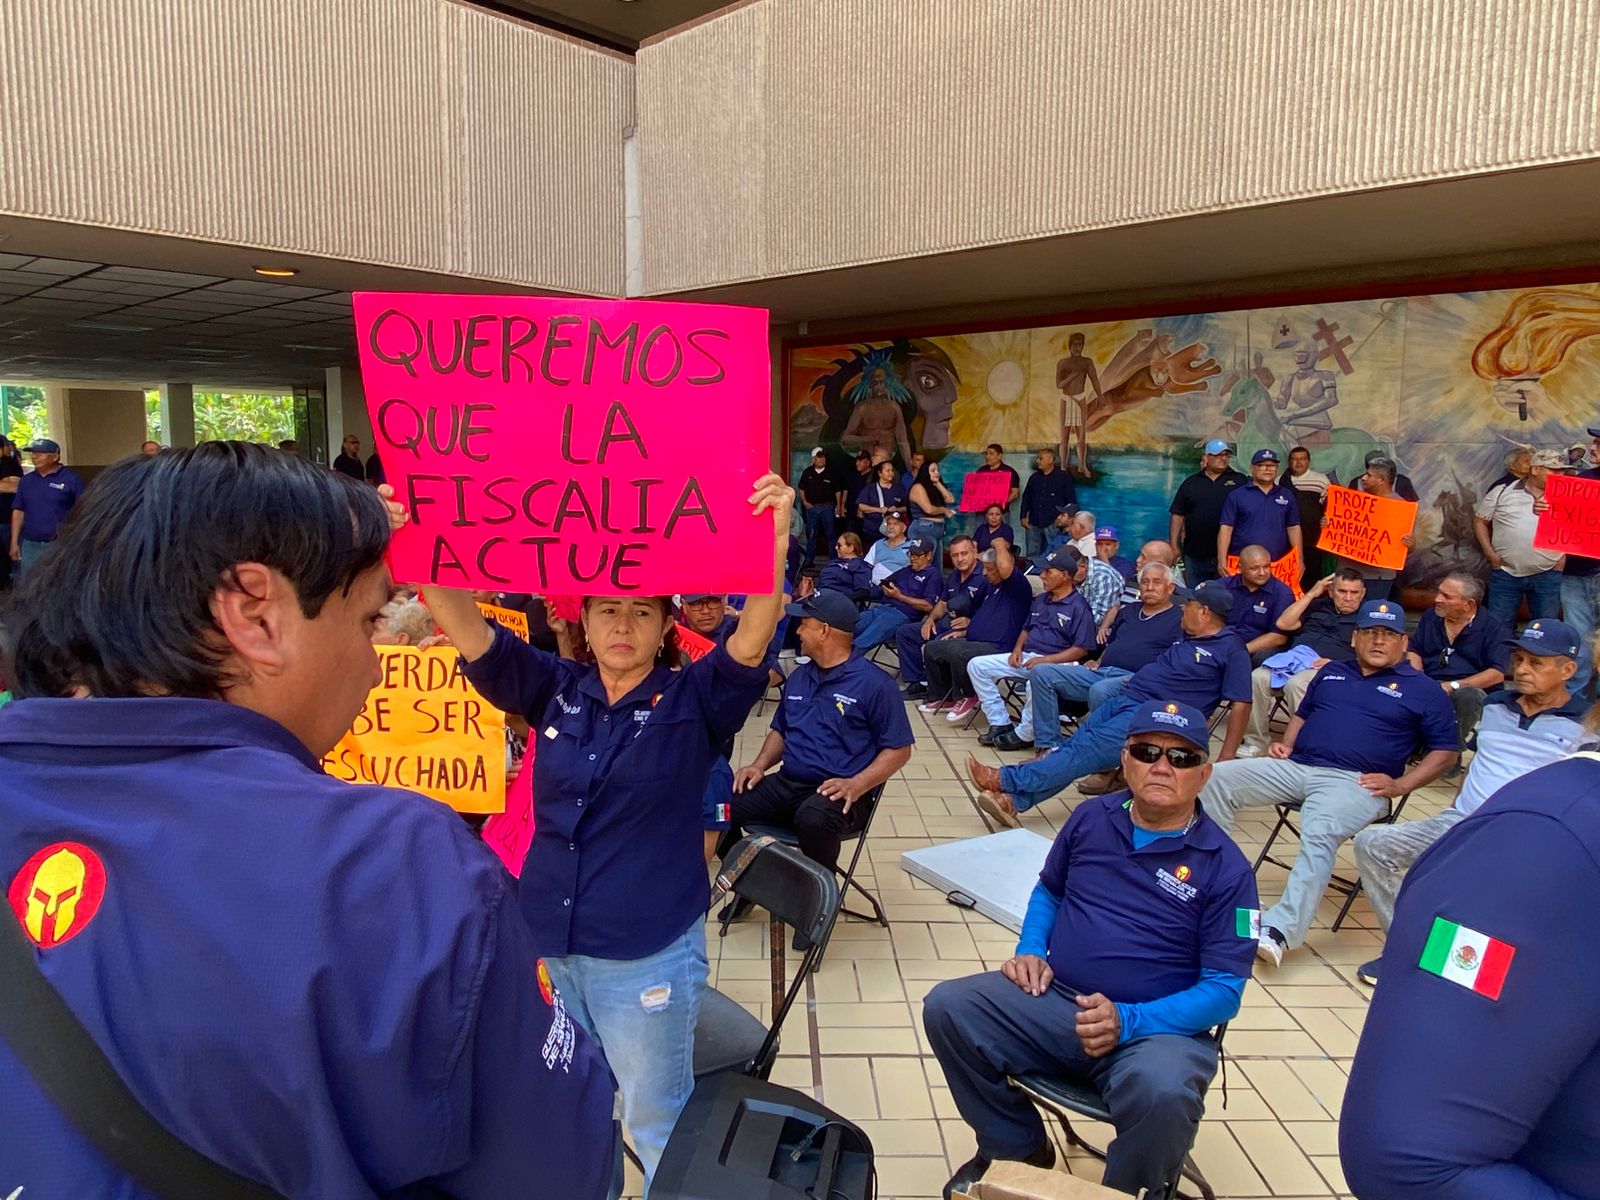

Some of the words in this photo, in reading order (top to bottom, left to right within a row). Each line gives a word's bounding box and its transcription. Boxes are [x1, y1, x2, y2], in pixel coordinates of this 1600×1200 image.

[369, 309, 730, 387] QUEREMOS
[377, 399, 494, 461] QUE
[561, 400, 648, 464] LA
[405, 474, 718, 539] FISCALIA
[1333, 506, 1371, 526] LOZA
[1334, 490, 1378, 514] PROFE
[1325, 531, 1382, 555] ACTIVISTA
[1326, 517, 1391, 545] AMENAZA
[430, 535, 649, 589] ACTUE
[1330, 542, 1378, 565] YESENIA
[379, 652, 468, 692] ERDA
[351, 697, 390, 736] BE
[412, 698, 485, 740] SER
